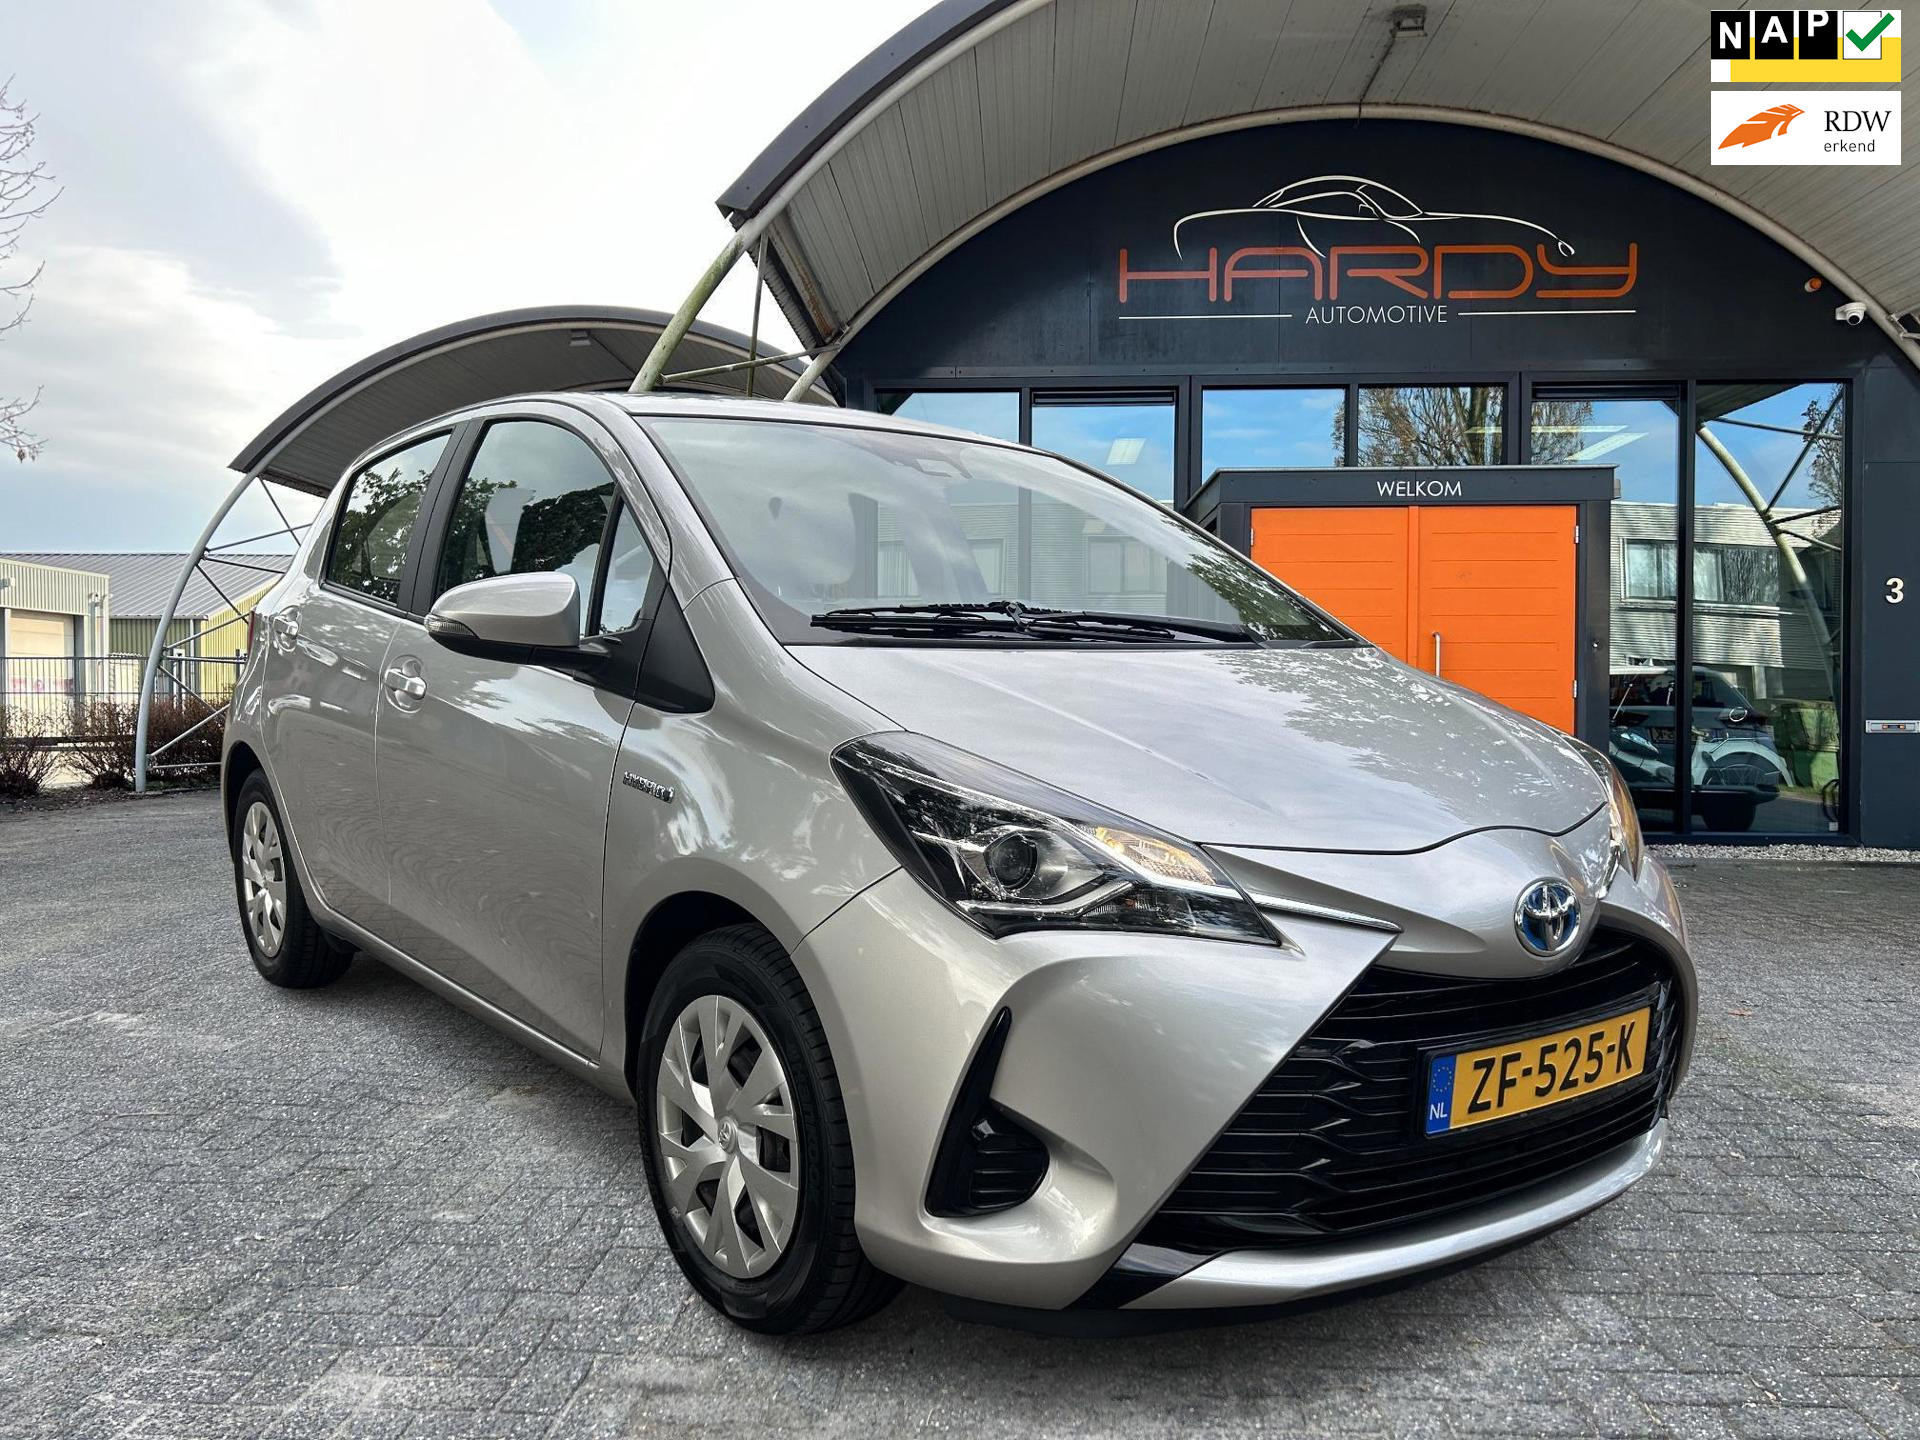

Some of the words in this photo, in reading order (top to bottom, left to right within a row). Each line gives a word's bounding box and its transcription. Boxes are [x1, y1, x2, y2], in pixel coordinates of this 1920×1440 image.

[1119, 242, 1638, 303] HARDY
[1305, 305, 1448, 325] AUTOMOTIVE
[1376, 480, 1462, 497] WELKOM
[1885, 577, 1904, 604] 3
[1467, 1021, 1636, 1115] ZF-525-K
[1429, 1102, 1448, 1121] NL
